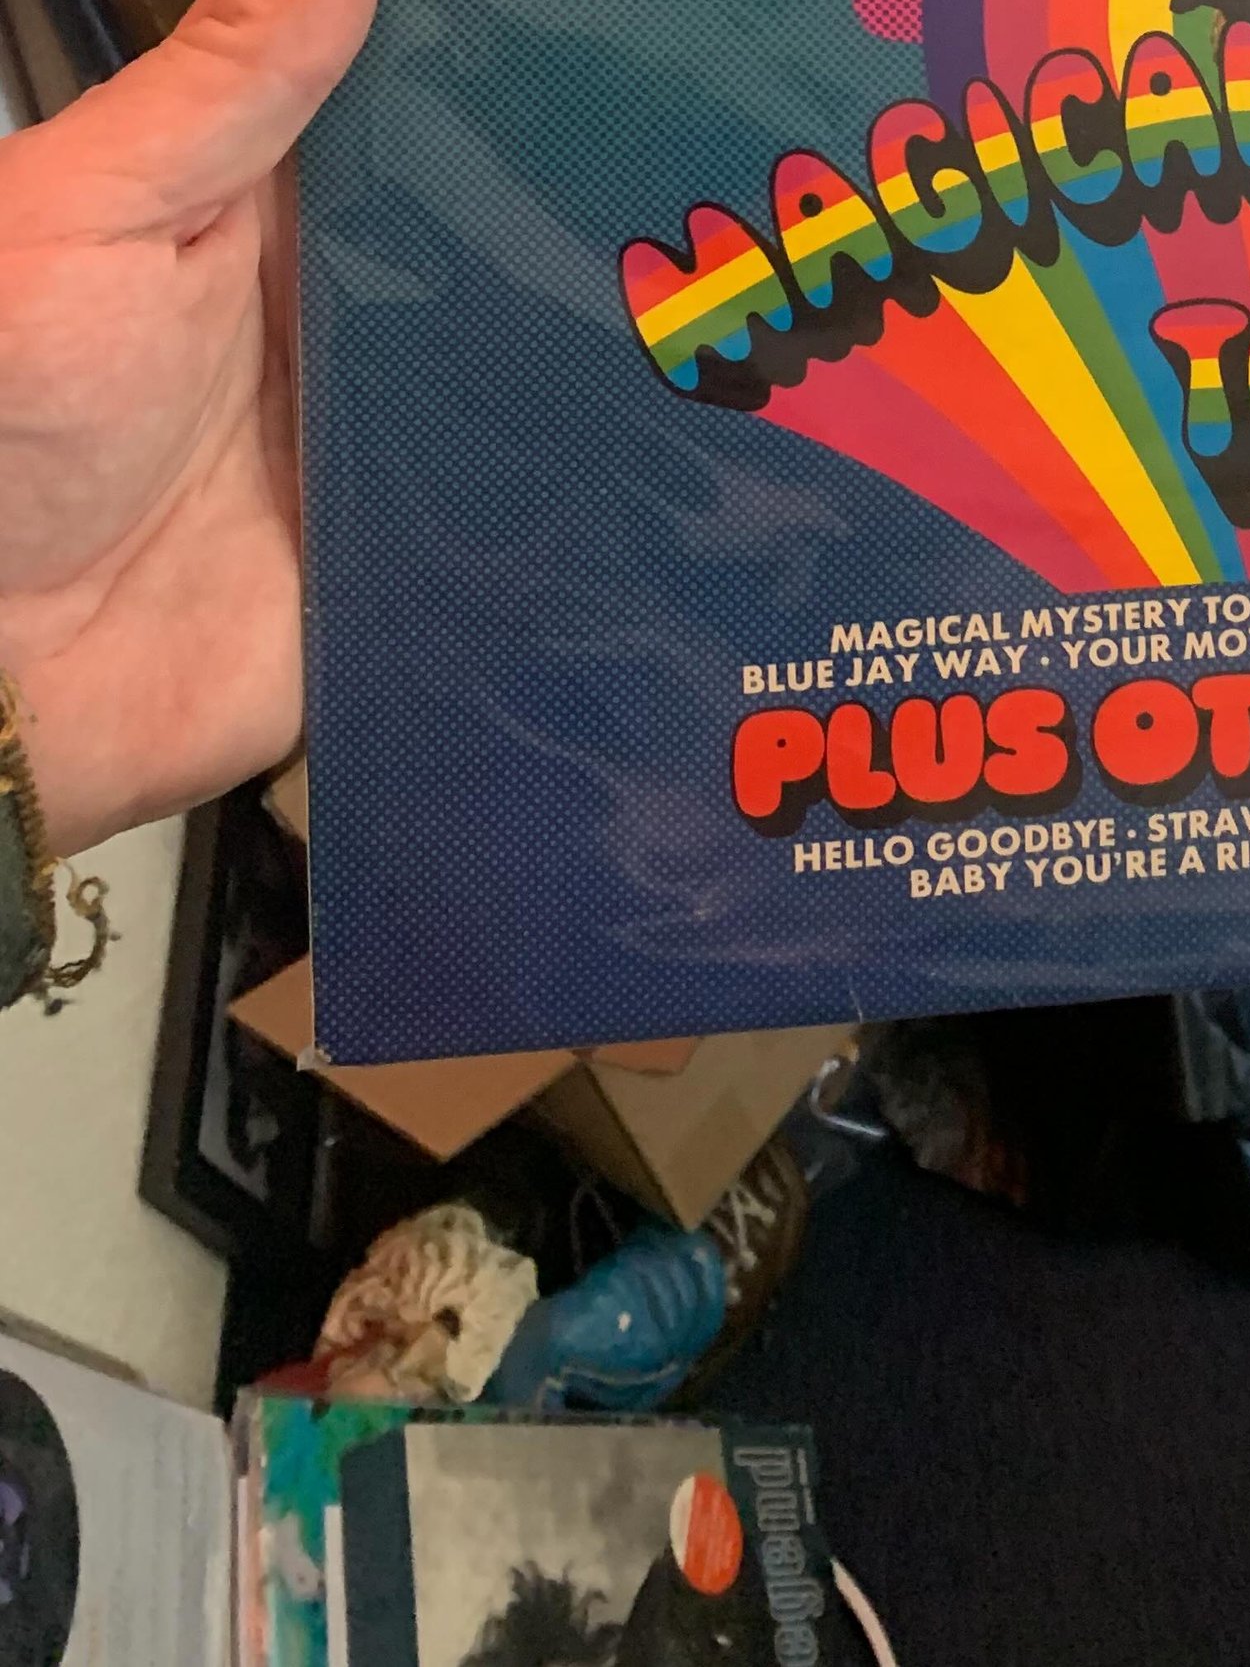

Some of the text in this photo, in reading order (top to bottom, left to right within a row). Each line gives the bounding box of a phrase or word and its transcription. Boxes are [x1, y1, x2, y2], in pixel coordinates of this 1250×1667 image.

[830, 611, 1010, 654] MAGICAL
[1020, 597, 1192, 639] MYSTERY
[742, 659, 835, 695] BLUE
[845, 652, 920, 687] JAY
[932, 644, 1028, 680] WAY
[1060, 634, 1173, 670] YOUR
[731, 685, 1076, 830] PLUS
[793, 835, 914, 873] HELLO
[927, 818, 1116, 861] GOODBYE
[909, 861, 1012, 899] BABY
[1025, 849, 1167, 887] YOU'RE
[1178, 845, 1206, 875] A
